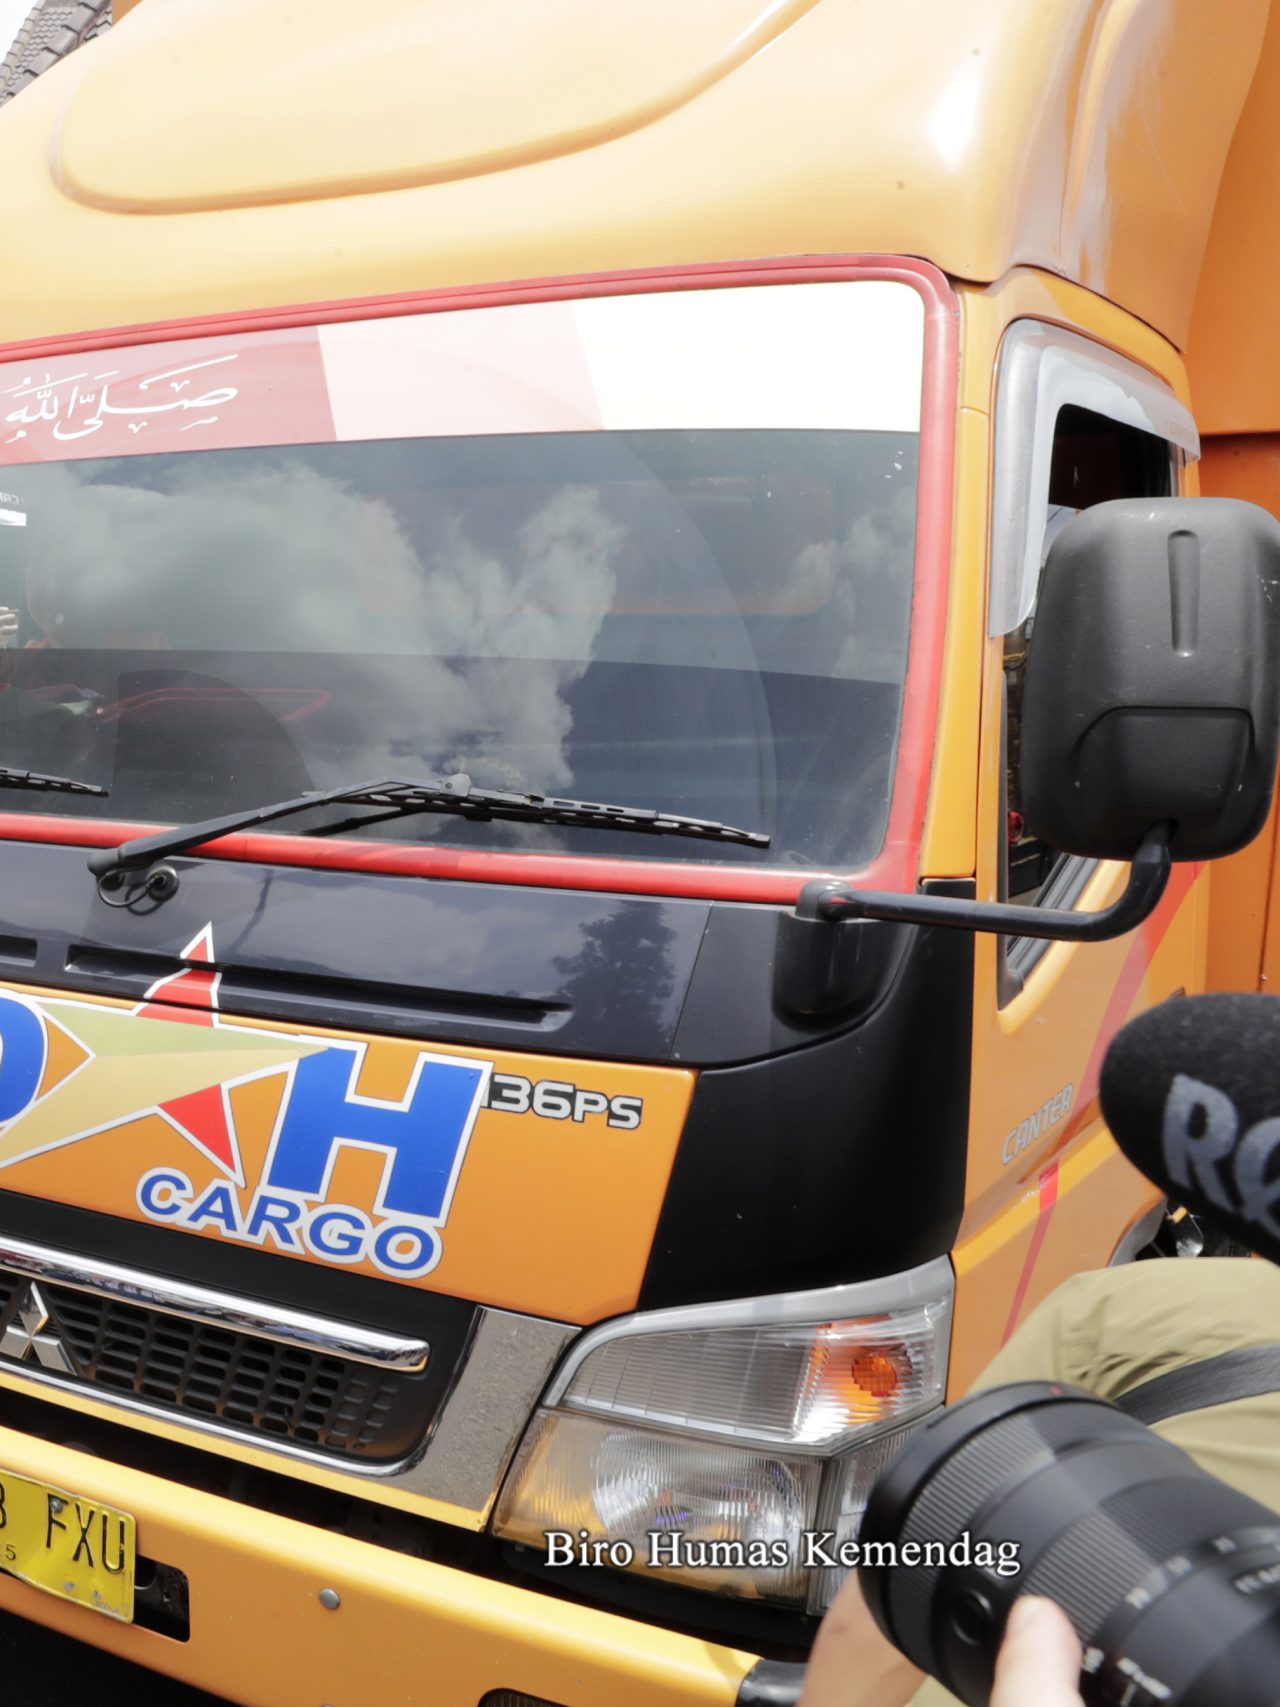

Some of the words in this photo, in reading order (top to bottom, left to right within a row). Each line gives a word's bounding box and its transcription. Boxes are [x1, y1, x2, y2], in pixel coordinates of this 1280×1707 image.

[1003, 1083, 1072, 1165] CANTER
[138, 1169, 442, 1277] CARGO
[46, 1492, 126, 1575] FXU
